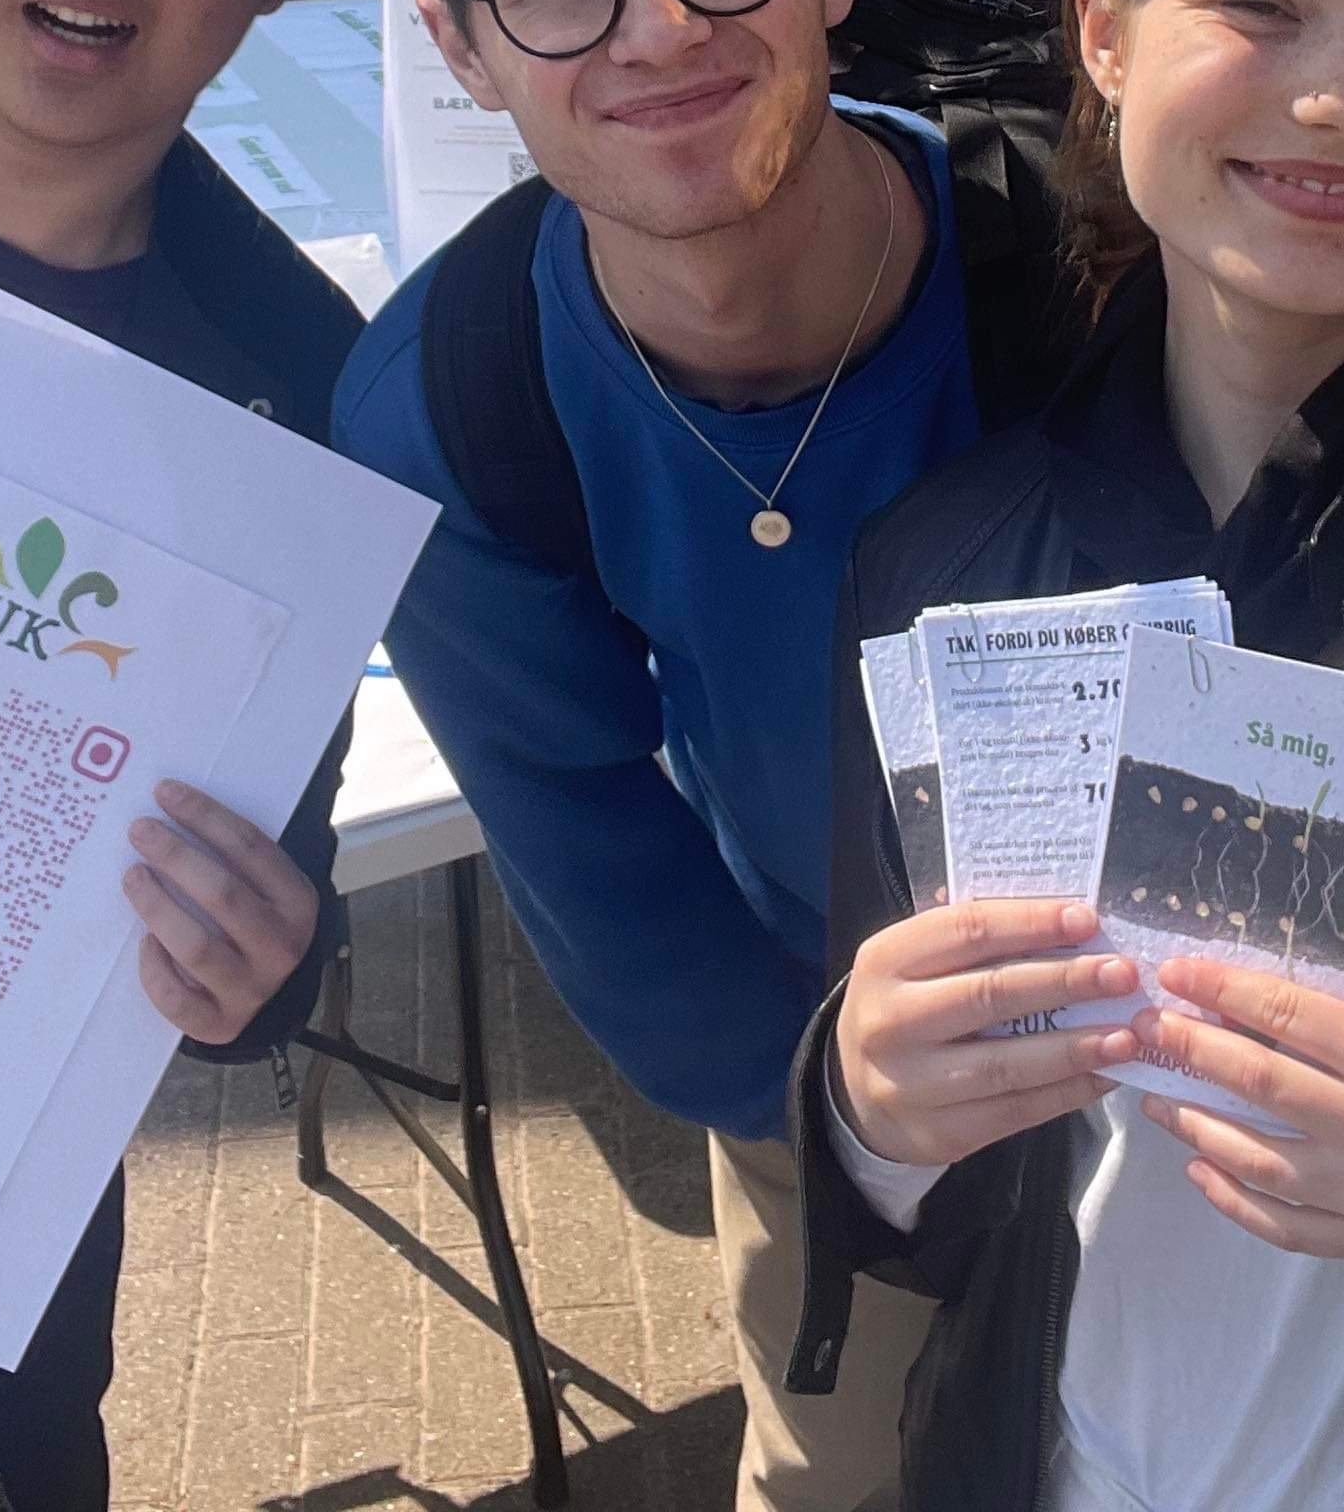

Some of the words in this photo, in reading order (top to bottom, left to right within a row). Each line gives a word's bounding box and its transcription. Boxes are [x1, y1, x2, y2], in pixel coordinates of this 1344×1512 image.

[985, 632, 1033, 652] FORDI
[1039, 630, 1059, 647] DU
[1064, 625, 1117, 646] KØBER
[1246, 720, 1275, 747] Så
[1280, 733, 1335, 768] mig,
